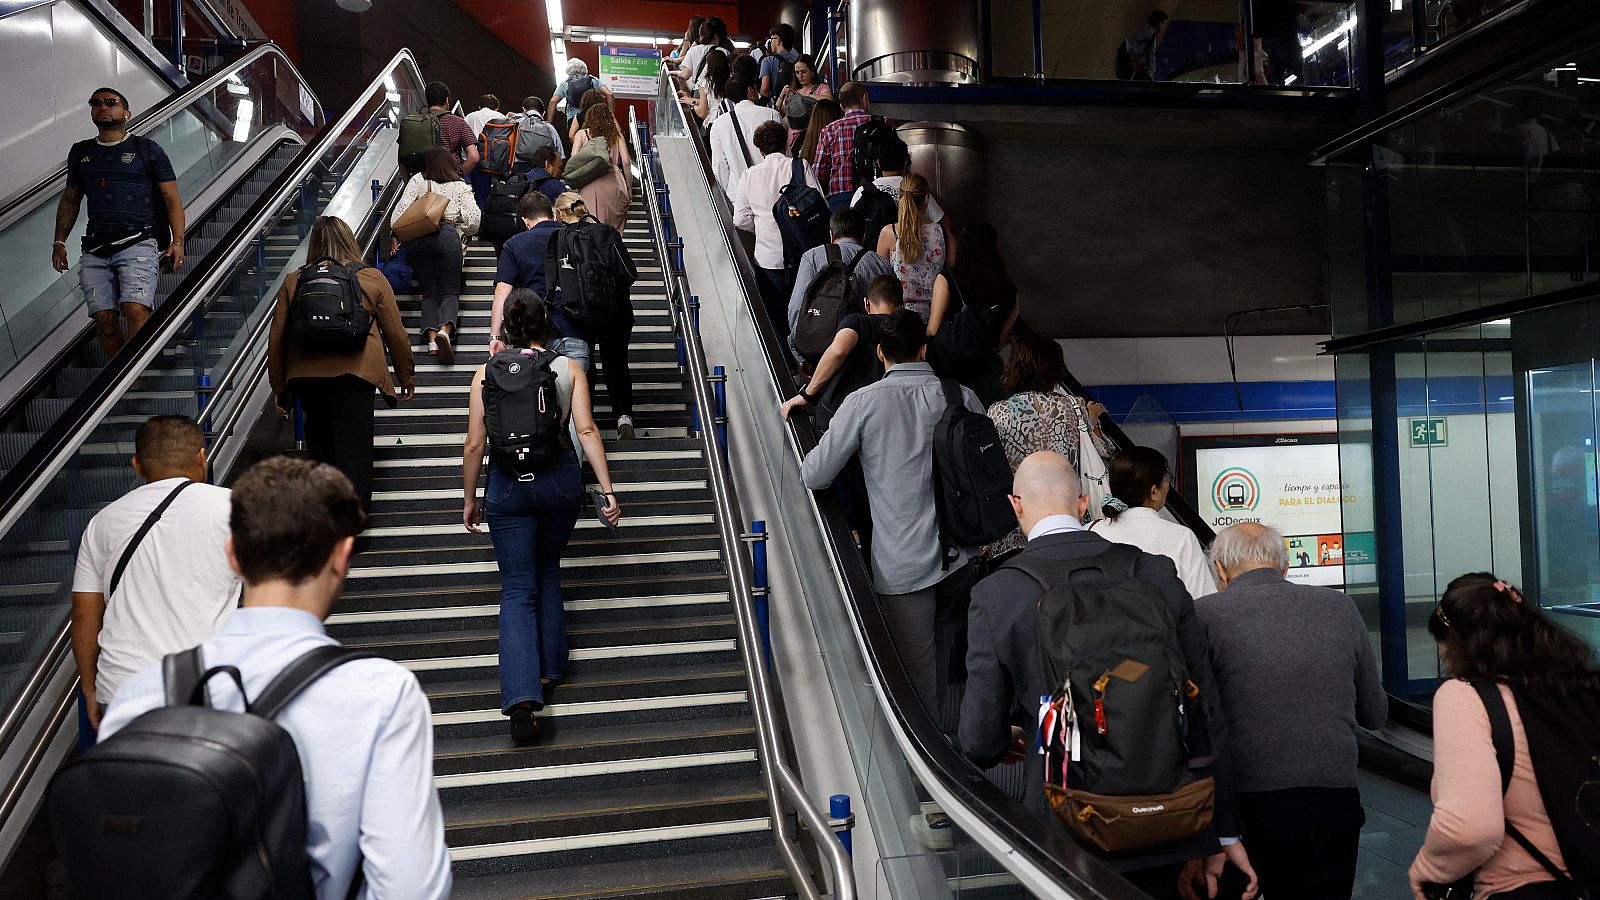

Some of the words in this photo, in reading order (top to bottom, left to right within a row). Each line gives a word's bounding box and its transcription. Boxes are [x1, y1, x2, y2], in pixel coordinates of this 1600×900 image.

[1284, 483, 1312, 494] tiempo
[1314, 485, 1319, 493] y
[1279, 498, 1302, 506] PARA
[1132, 805, 1164, 813] Quechua
